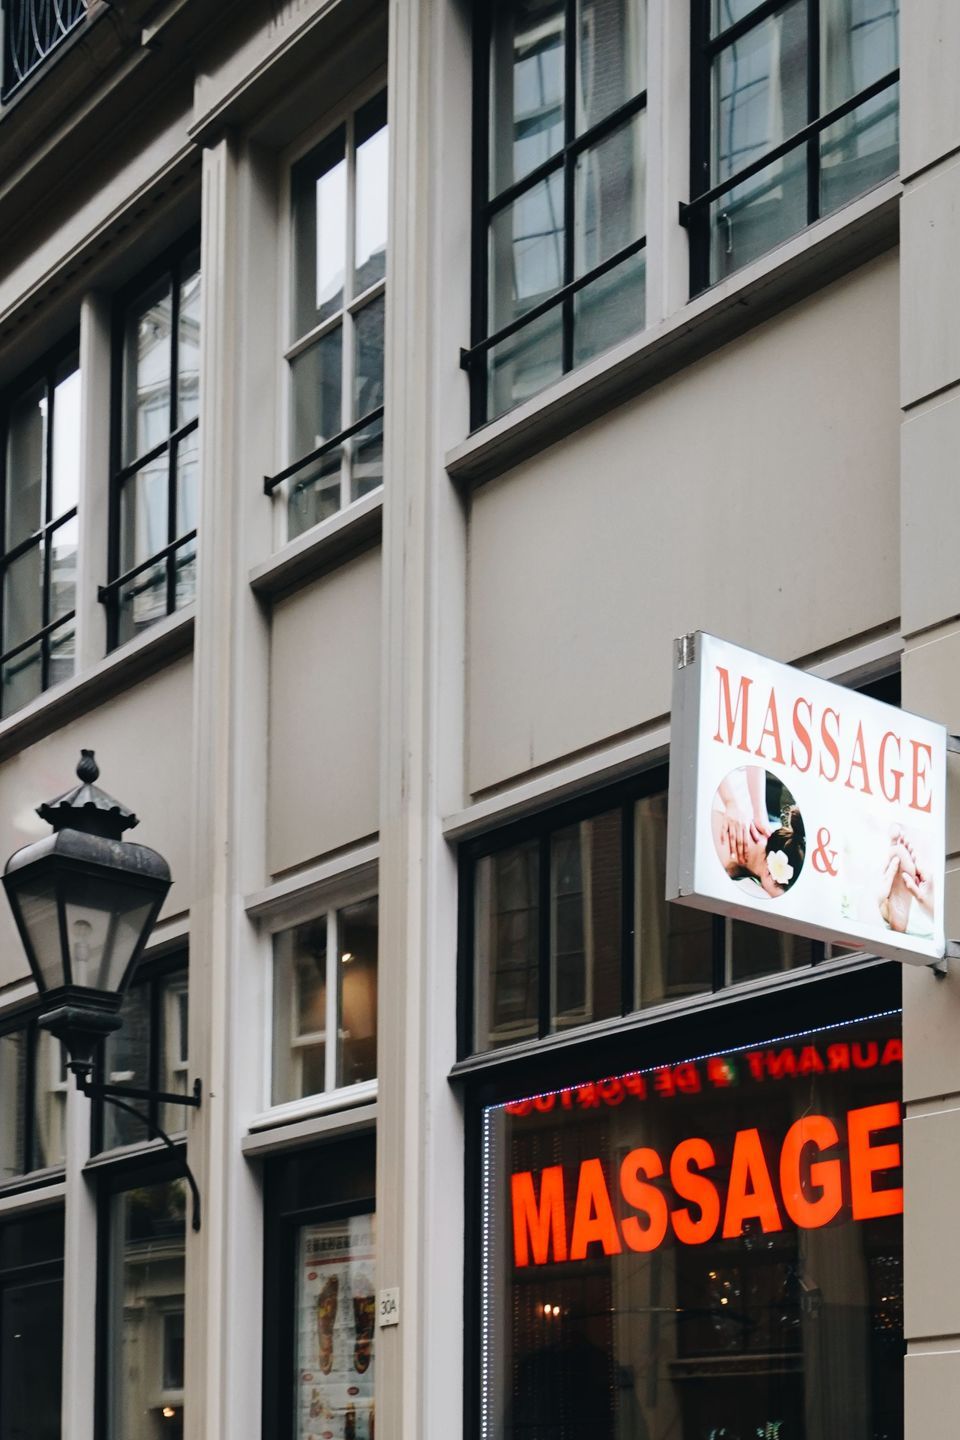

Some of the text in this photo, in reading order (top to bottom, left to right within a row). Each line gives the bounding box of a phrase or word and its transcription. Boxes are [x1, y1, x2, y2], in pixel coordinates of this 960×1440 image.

[712, 666, 932, 813] MASSAGE
[811, 827, 838, 877] &
[511, 1100, 904, 1268] MASSAGE
[381, 1299, 397, 1315] 30A
